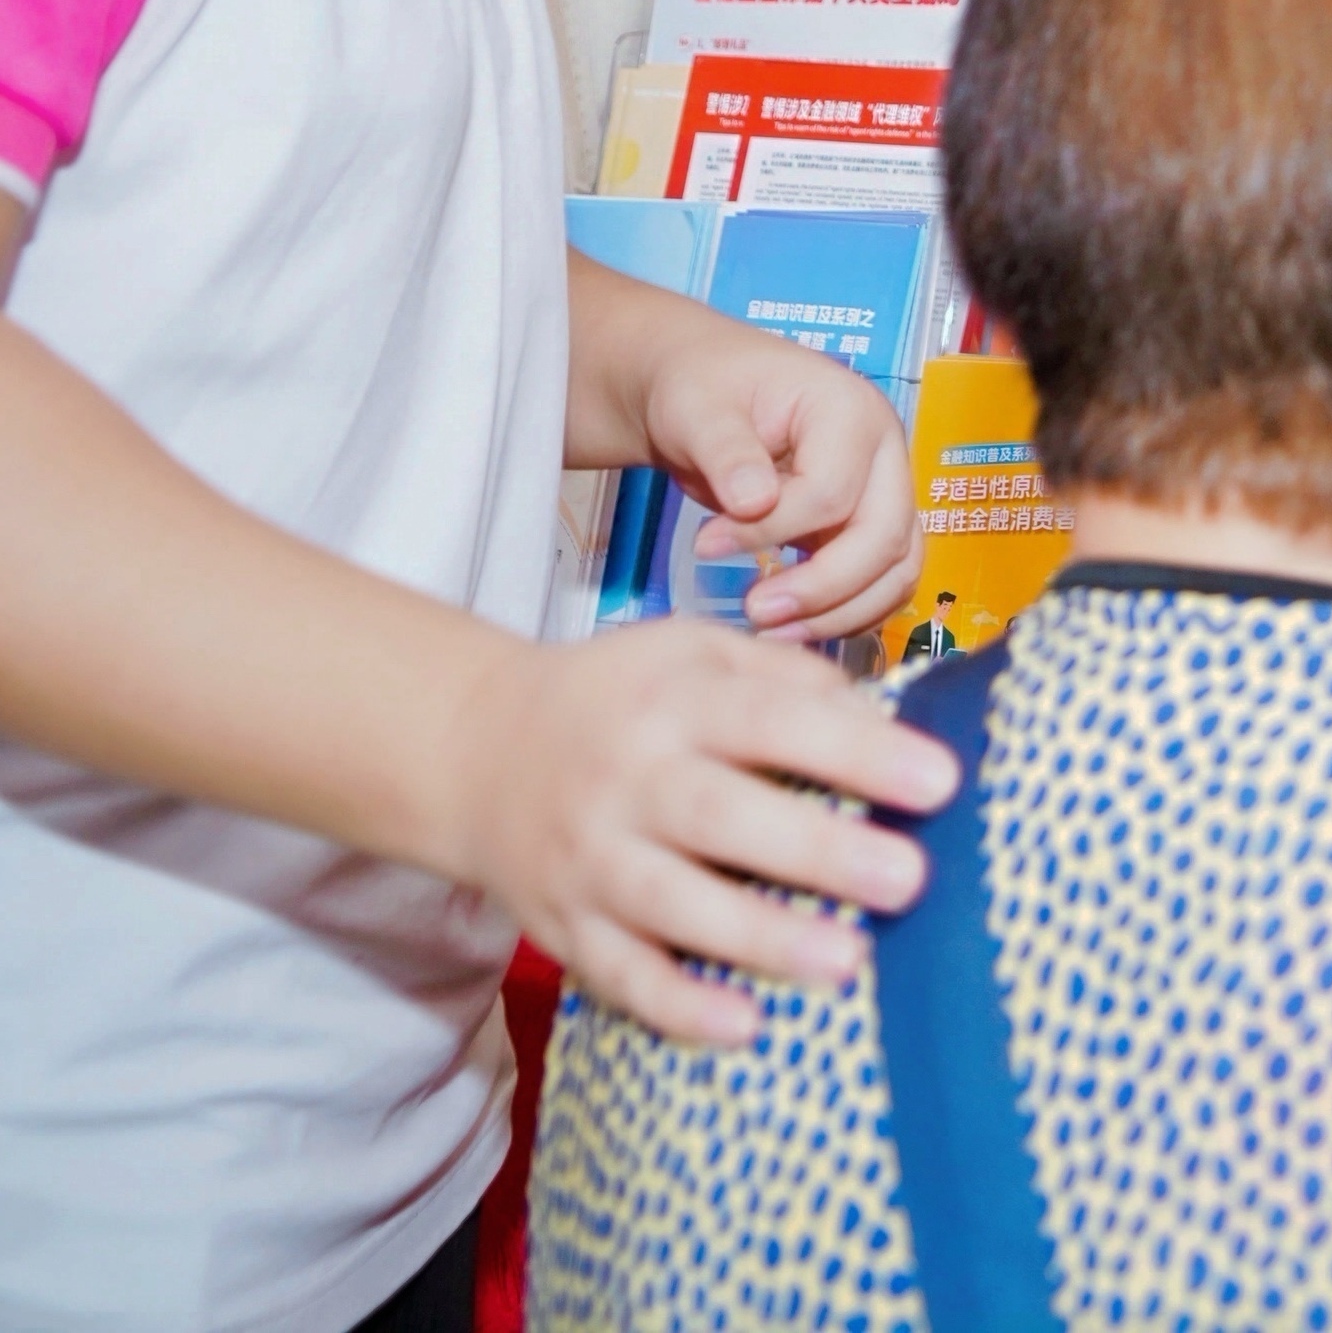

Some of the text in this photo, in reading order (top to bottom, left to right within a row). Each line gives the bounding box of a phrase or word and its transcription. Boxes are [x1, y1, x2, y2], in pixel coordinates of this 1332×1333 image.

[747, 300, 876, 328] 金融知识普及系列之
